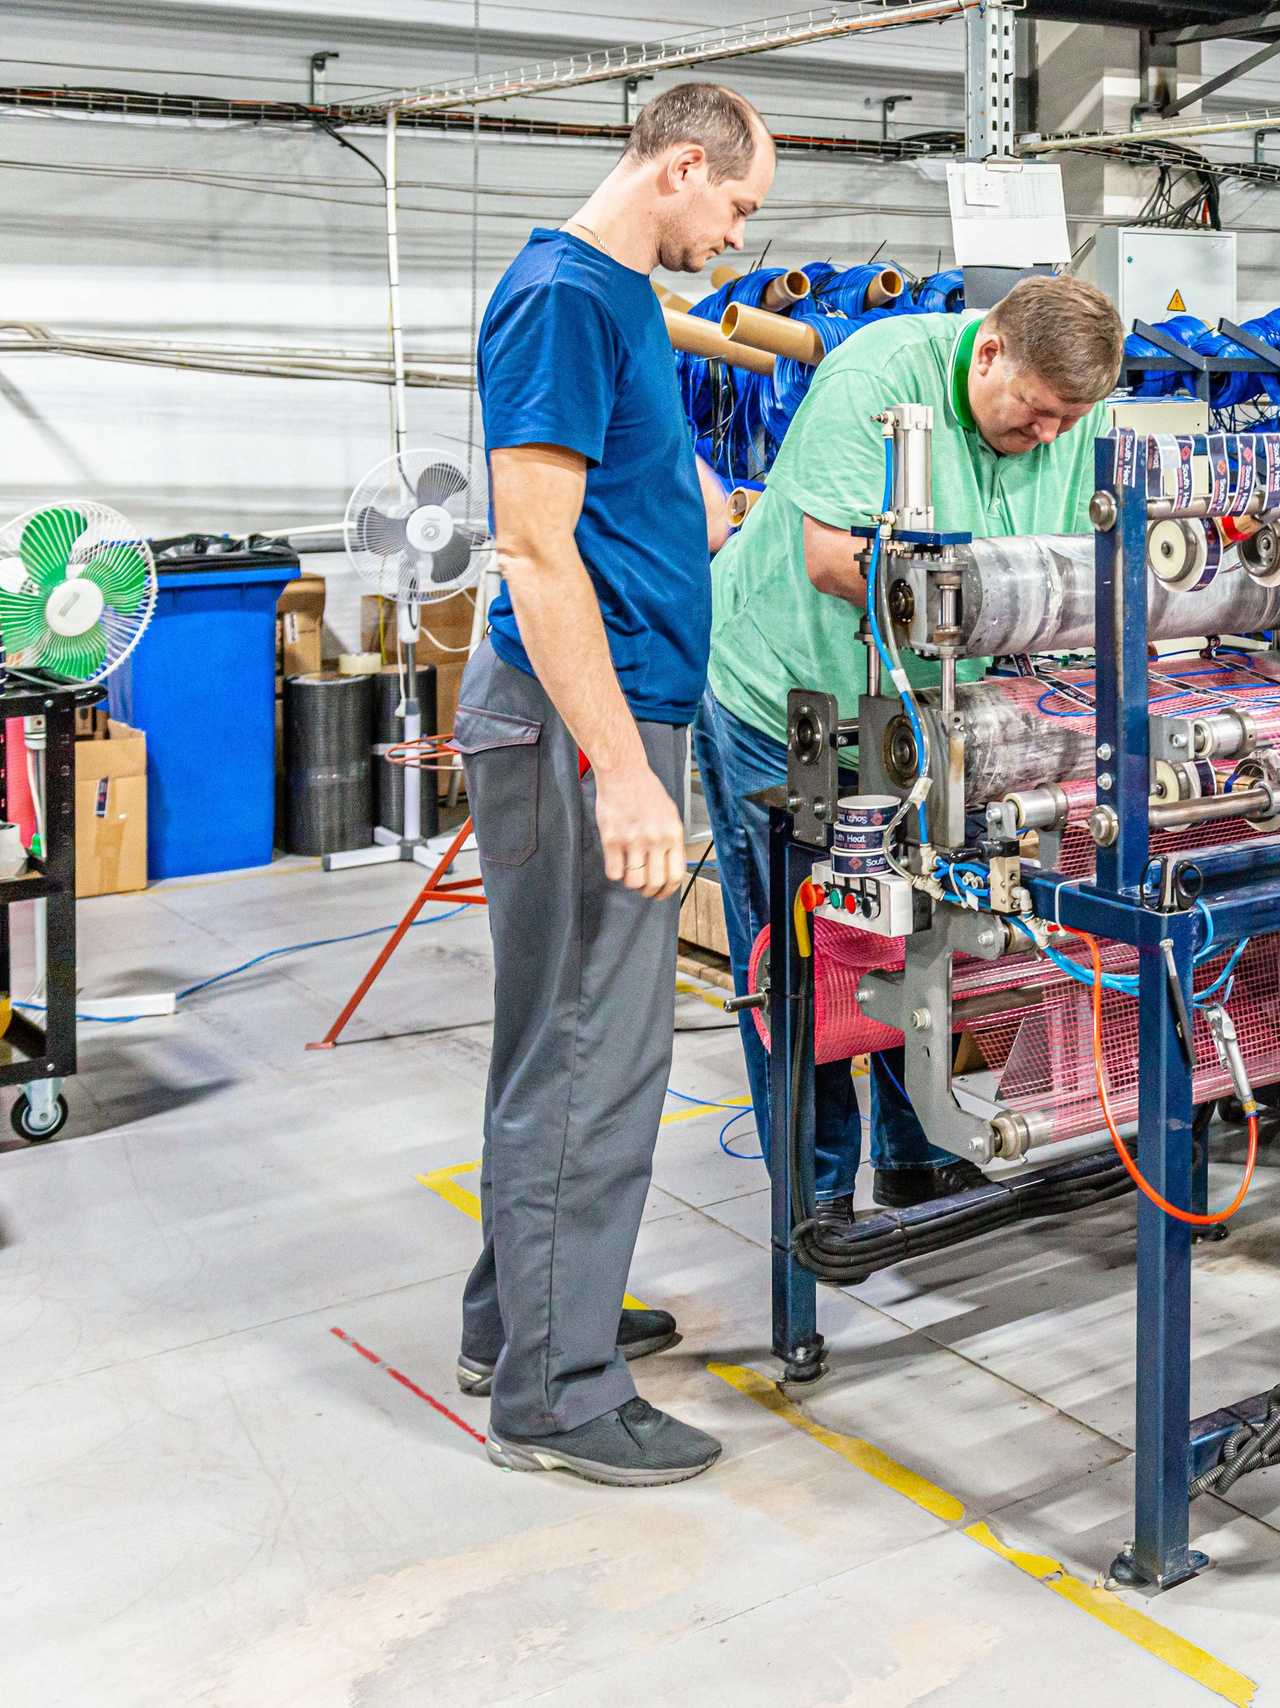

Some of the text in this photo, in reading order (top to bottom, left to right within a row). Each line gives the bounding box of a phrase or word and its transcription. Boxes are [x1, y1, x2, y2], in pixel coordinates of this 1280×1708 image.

[1122, 434, 1133, 485] South Hea
[1272, 443, 1280, 467] South
[1182, 463, 1191, 489] South
[1242, 465, 1252, 490] South
[1217, 478, 1226, 503] South
[846, 813, 868, 824] South
[847, 834, 866, 843] Heat
[865, 857, 887, 867] South
